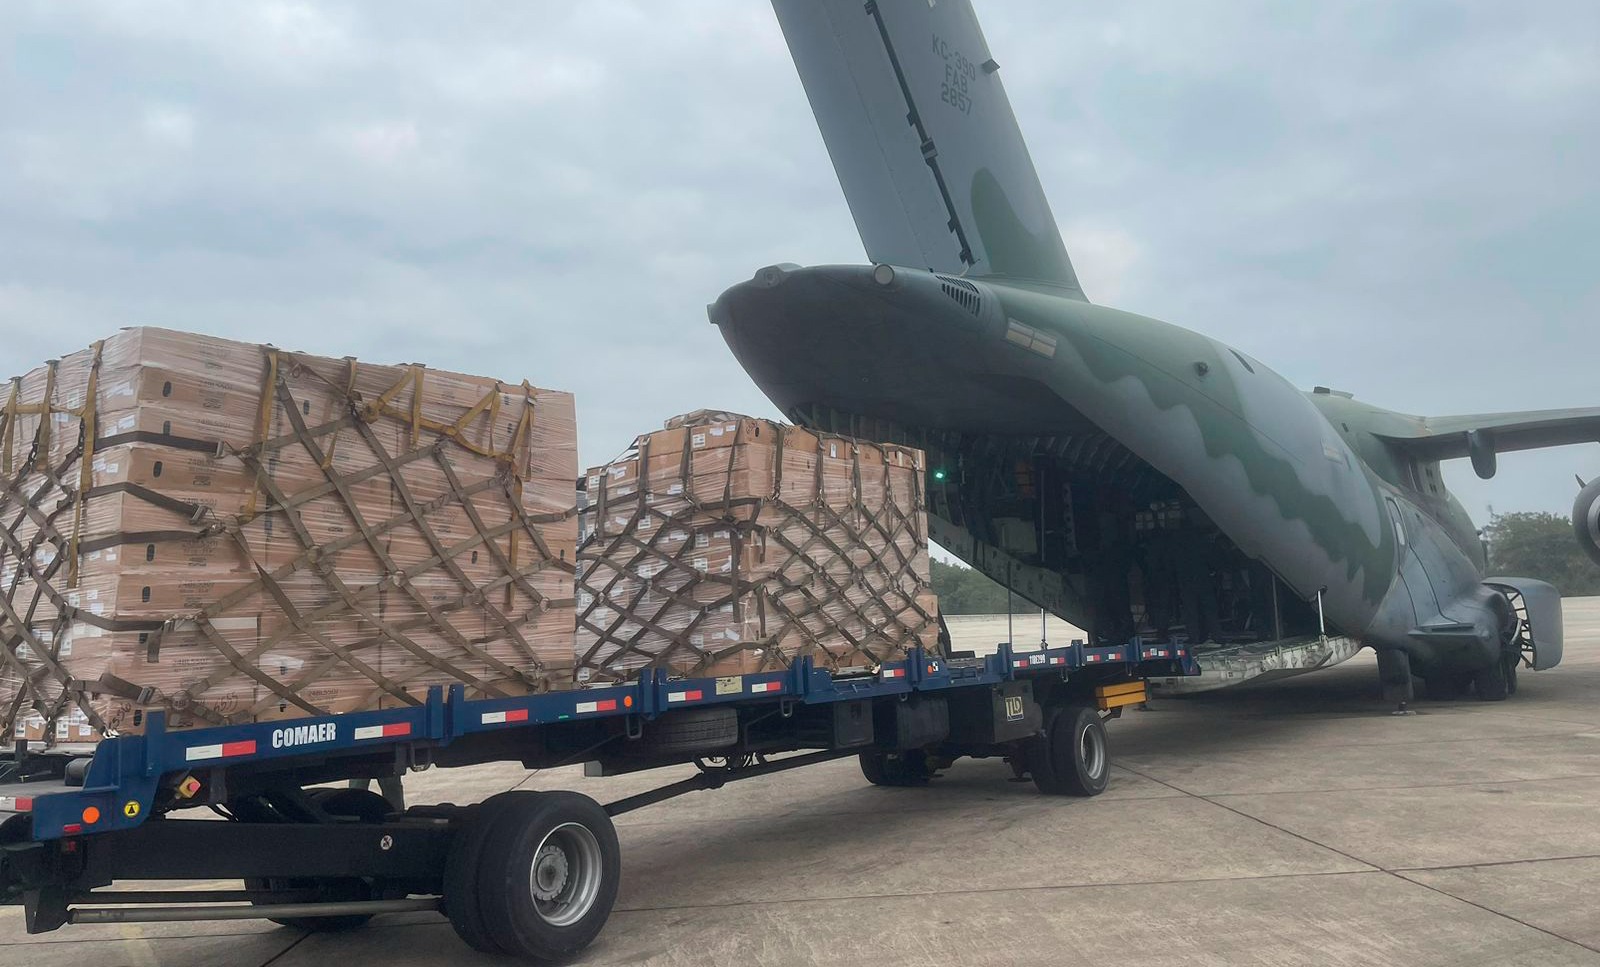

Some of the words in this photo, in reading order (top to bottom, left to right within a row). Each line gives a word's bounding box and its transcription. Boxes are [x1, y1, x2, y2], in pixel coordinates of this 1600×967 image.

[932, 33, 976, 81] KC-390
[945, 63, 968, 94] FAB
[941, 82, 972, 115] 2857
[1005, 697, 1023, 716] TLD
[272, 722, 337, 749] COMAER
